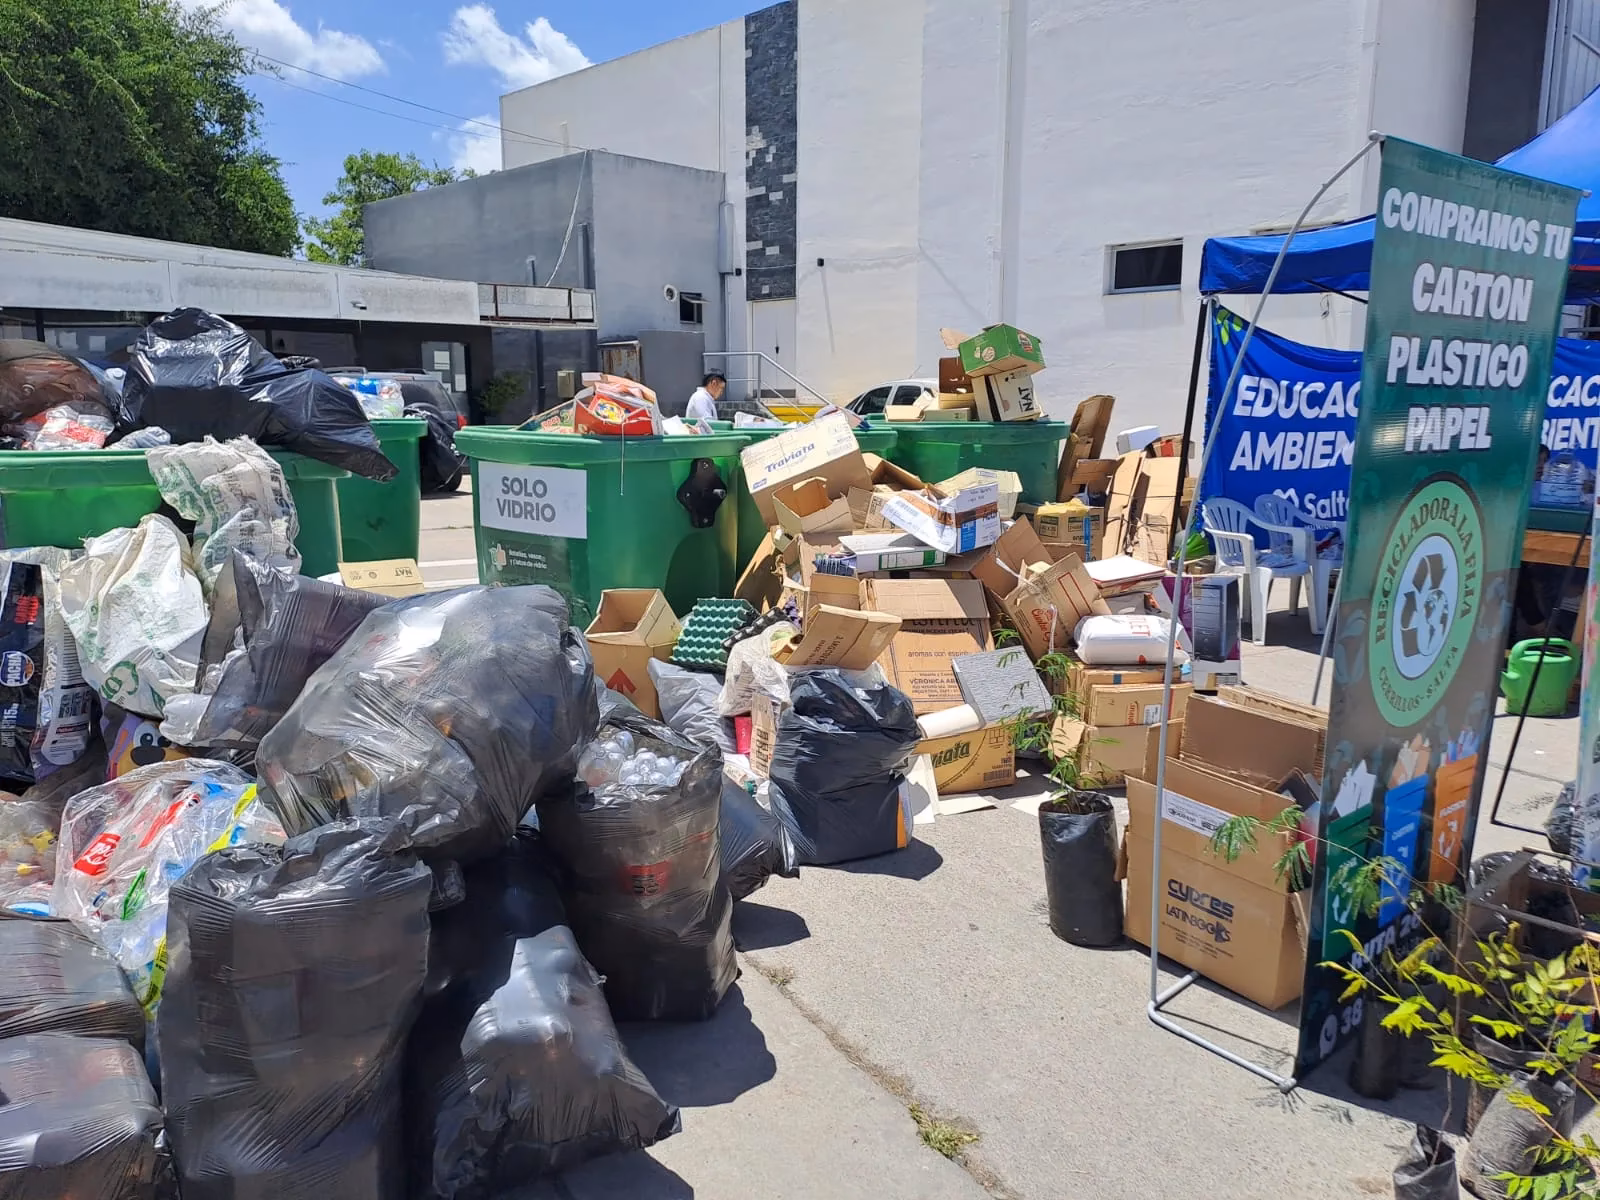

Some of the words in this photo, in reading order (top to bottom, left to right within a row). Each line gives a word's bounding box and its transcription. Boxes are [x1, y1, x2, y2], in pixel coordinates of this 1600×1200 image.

[1382, 187, 1541, 255] COMPRAMOS
[1543, 223, 1572, 260] TU
[1412, 262, 1534, 322] CARTON
[1386, 335, 1529, 388] PLASTICO
[1404, 406, 1493, 452] PAPEL
[765, 443, 815, 473] Traviata
[501, 475, 548, 499] SOLO
[496, 498, 556, 523] VIDRIO
